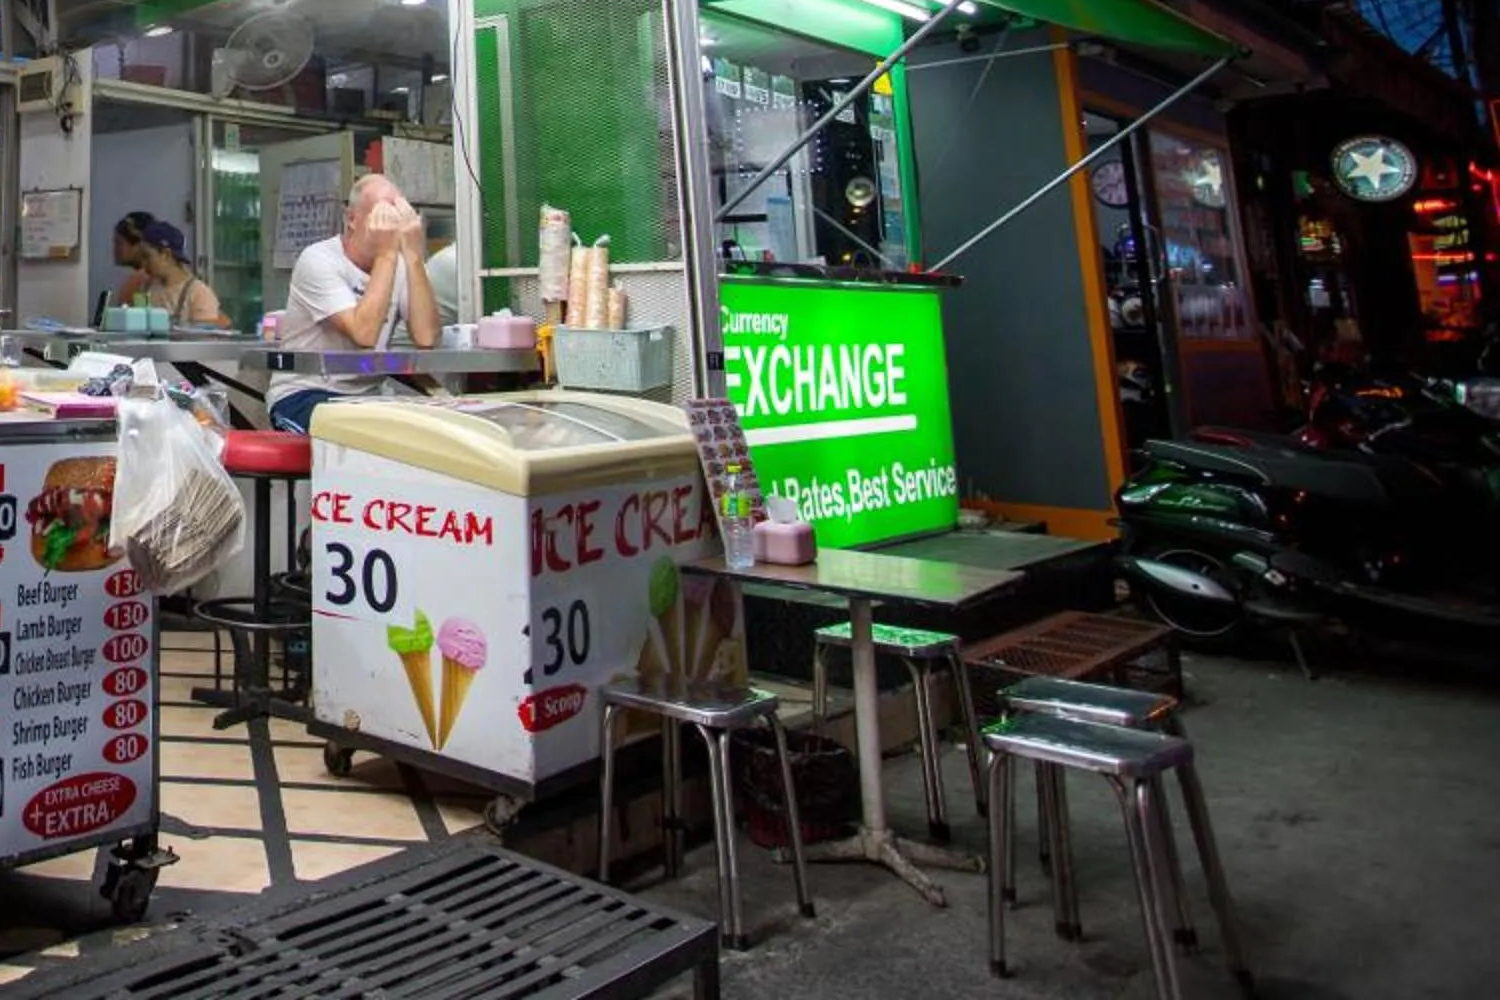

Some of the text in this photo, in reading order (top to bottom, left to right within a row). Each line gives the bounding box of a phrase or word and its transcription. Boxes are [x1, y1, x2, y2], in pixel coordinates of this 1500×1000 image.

[724, 343, 907, 418] EXCHANGE
[891, 457, 957, 504] Service
[362, 499, 494, 547] CREAM
[531, 484, 720, 578] ICE CRE
[112, 573, 144, 595] 130
[324, 541, 398, 614] 30
[17, 580, 79, 608] Beef Burger
[16, 614, 83, 641] Lamb Burger
[112, 603, 144, 628] 130
[112, 636, 144, 661] 100
[541, 599, 591, 677] 30
[14, 652, 47, 676] Chicken
[12, 680, 92, 711] Chicken Burger
[114, 671, 137, 692] 80
[114, 704, 137, 725] 80
[544, 690, 583, 718] Scoop
[11, 715, 89, 747] Shrimp Burger
[114, 737, 138, 759] 80
[11, 752, 73, 782] Fish Burger
[44, 776, 121, 806] EXTRA CHEESE
